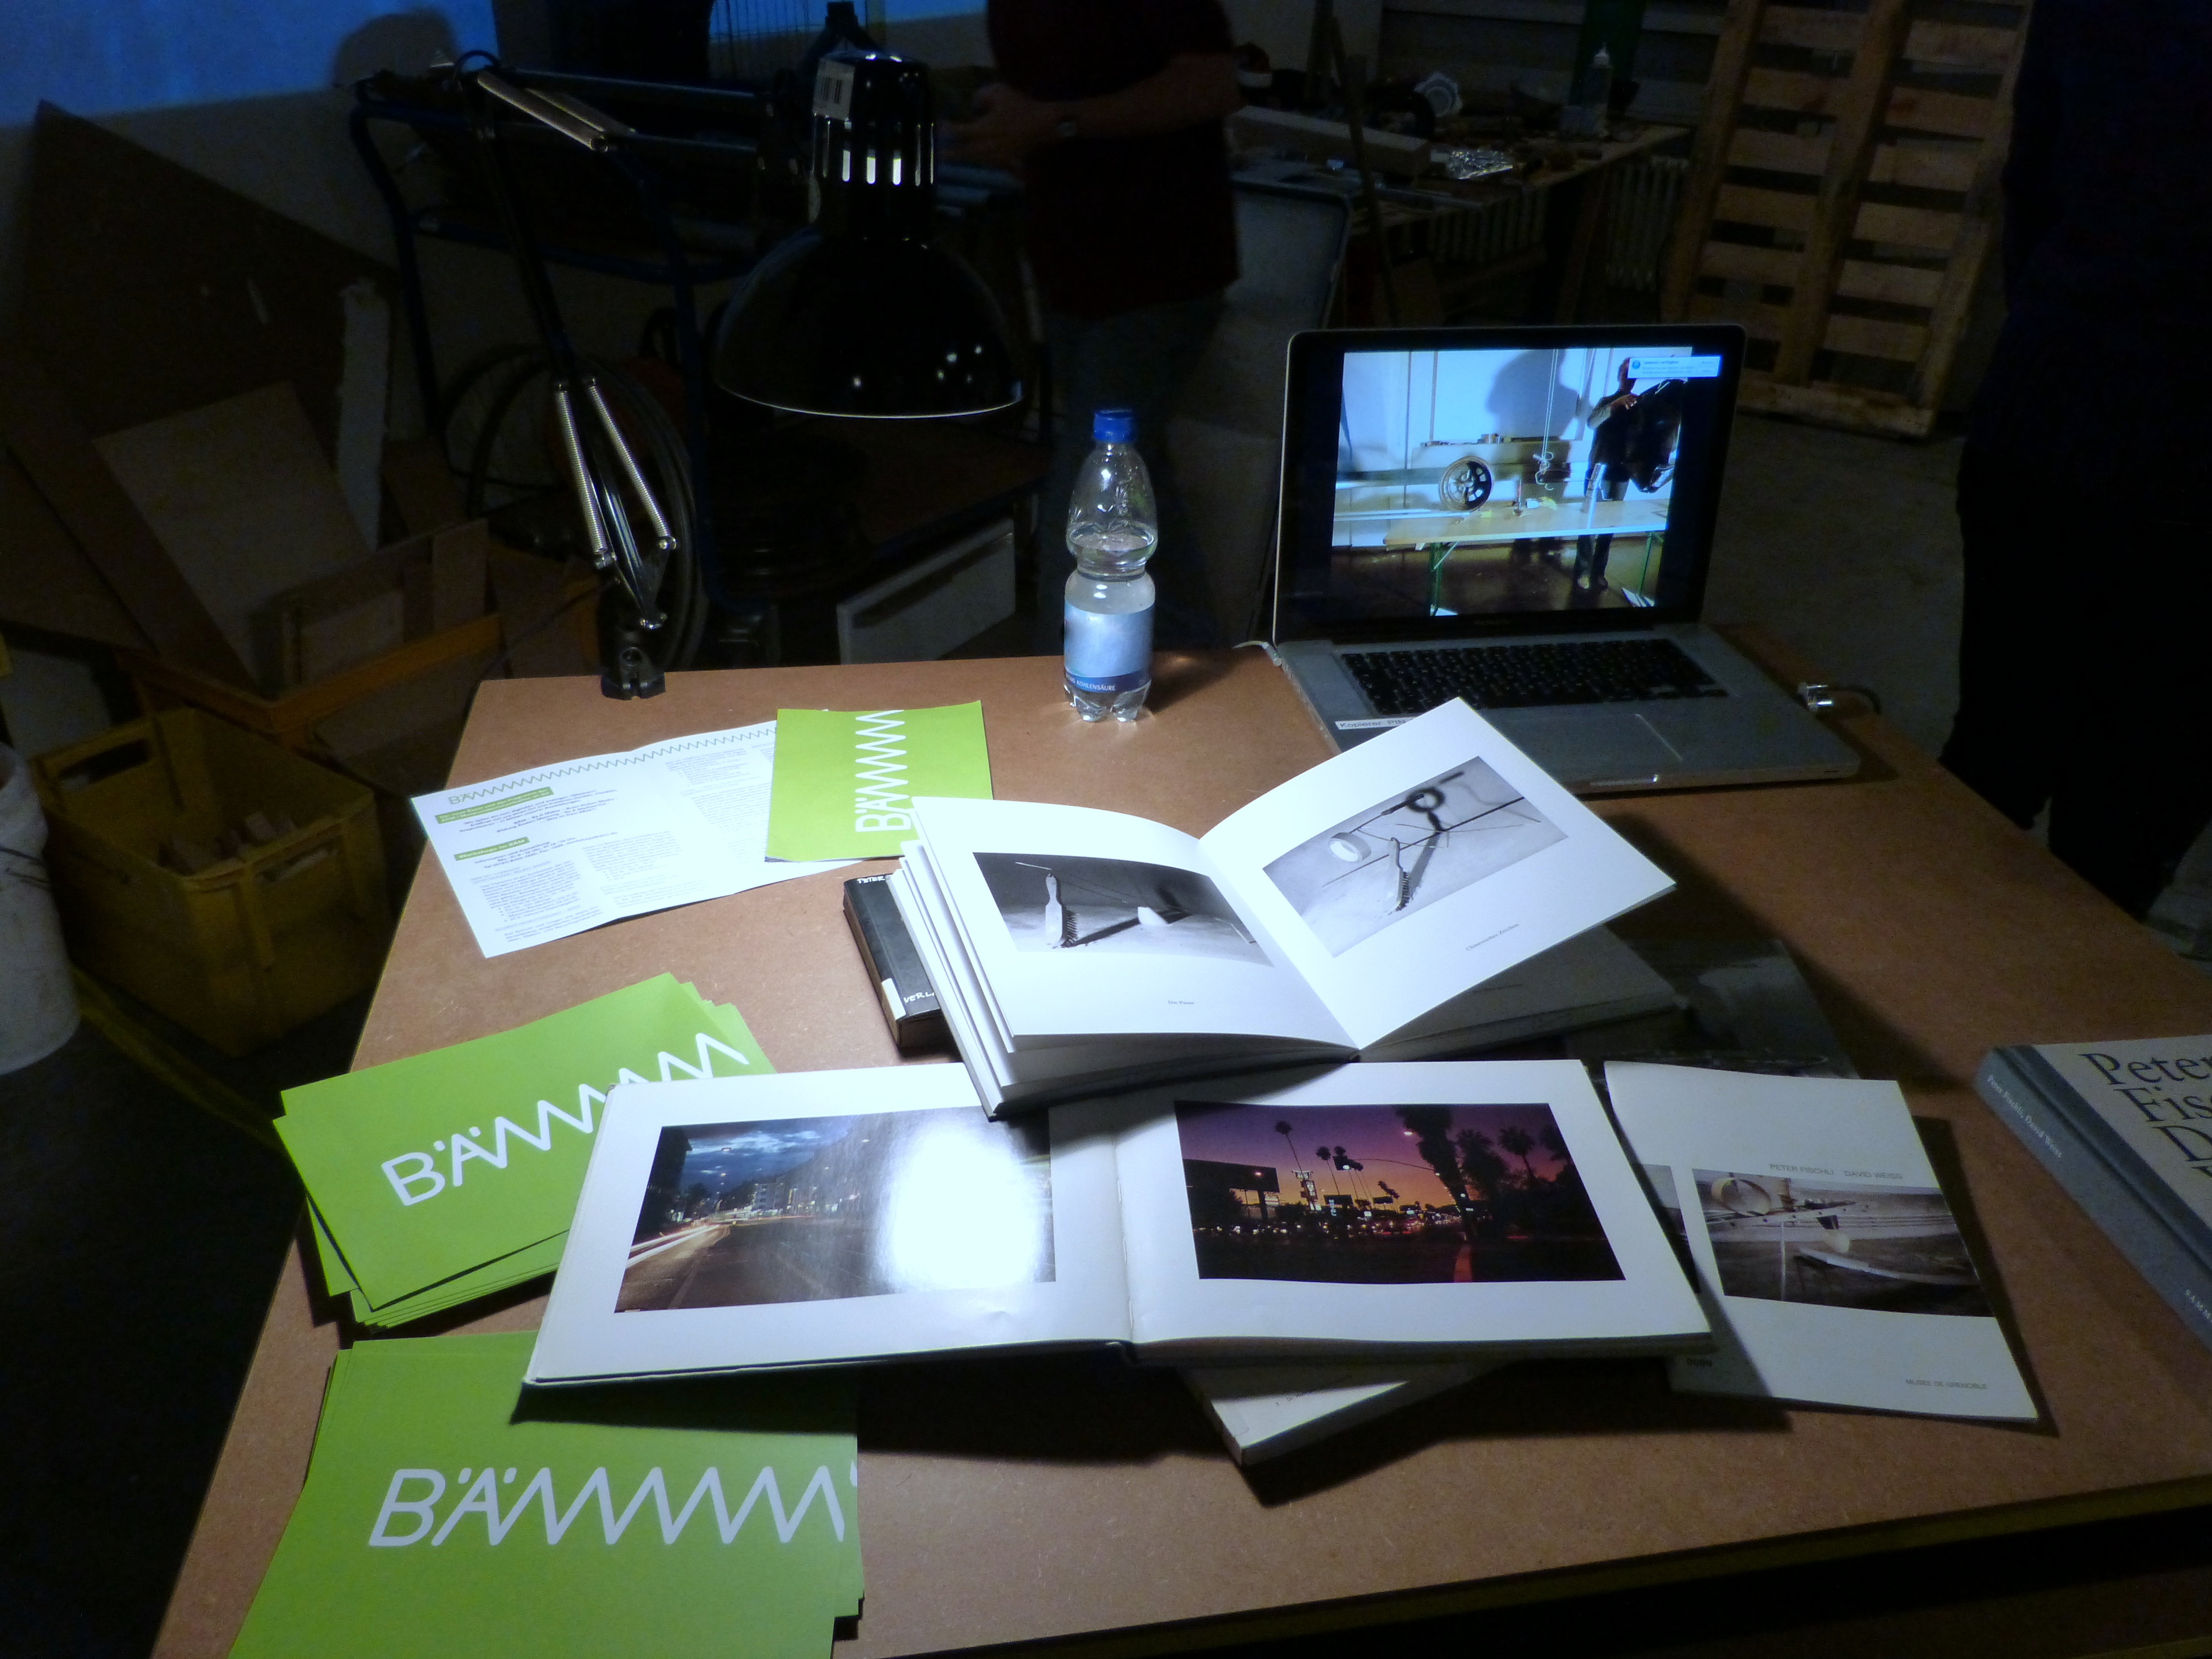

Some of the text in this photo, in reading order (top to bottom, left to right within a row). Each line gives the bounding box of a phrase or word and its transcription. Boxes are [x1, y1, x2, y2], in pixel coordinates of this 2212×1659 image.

[1077, 680, 1116, 691] KOHLENSÄURE
[1770, 1164, 1798, 1172] PETER
[1800, 1166, 1834, 1176] FISCHLI
[1873, 1172, 1903, 1180] WEISS
[1946, 1381, 1987, 1390] GRENOBLE
